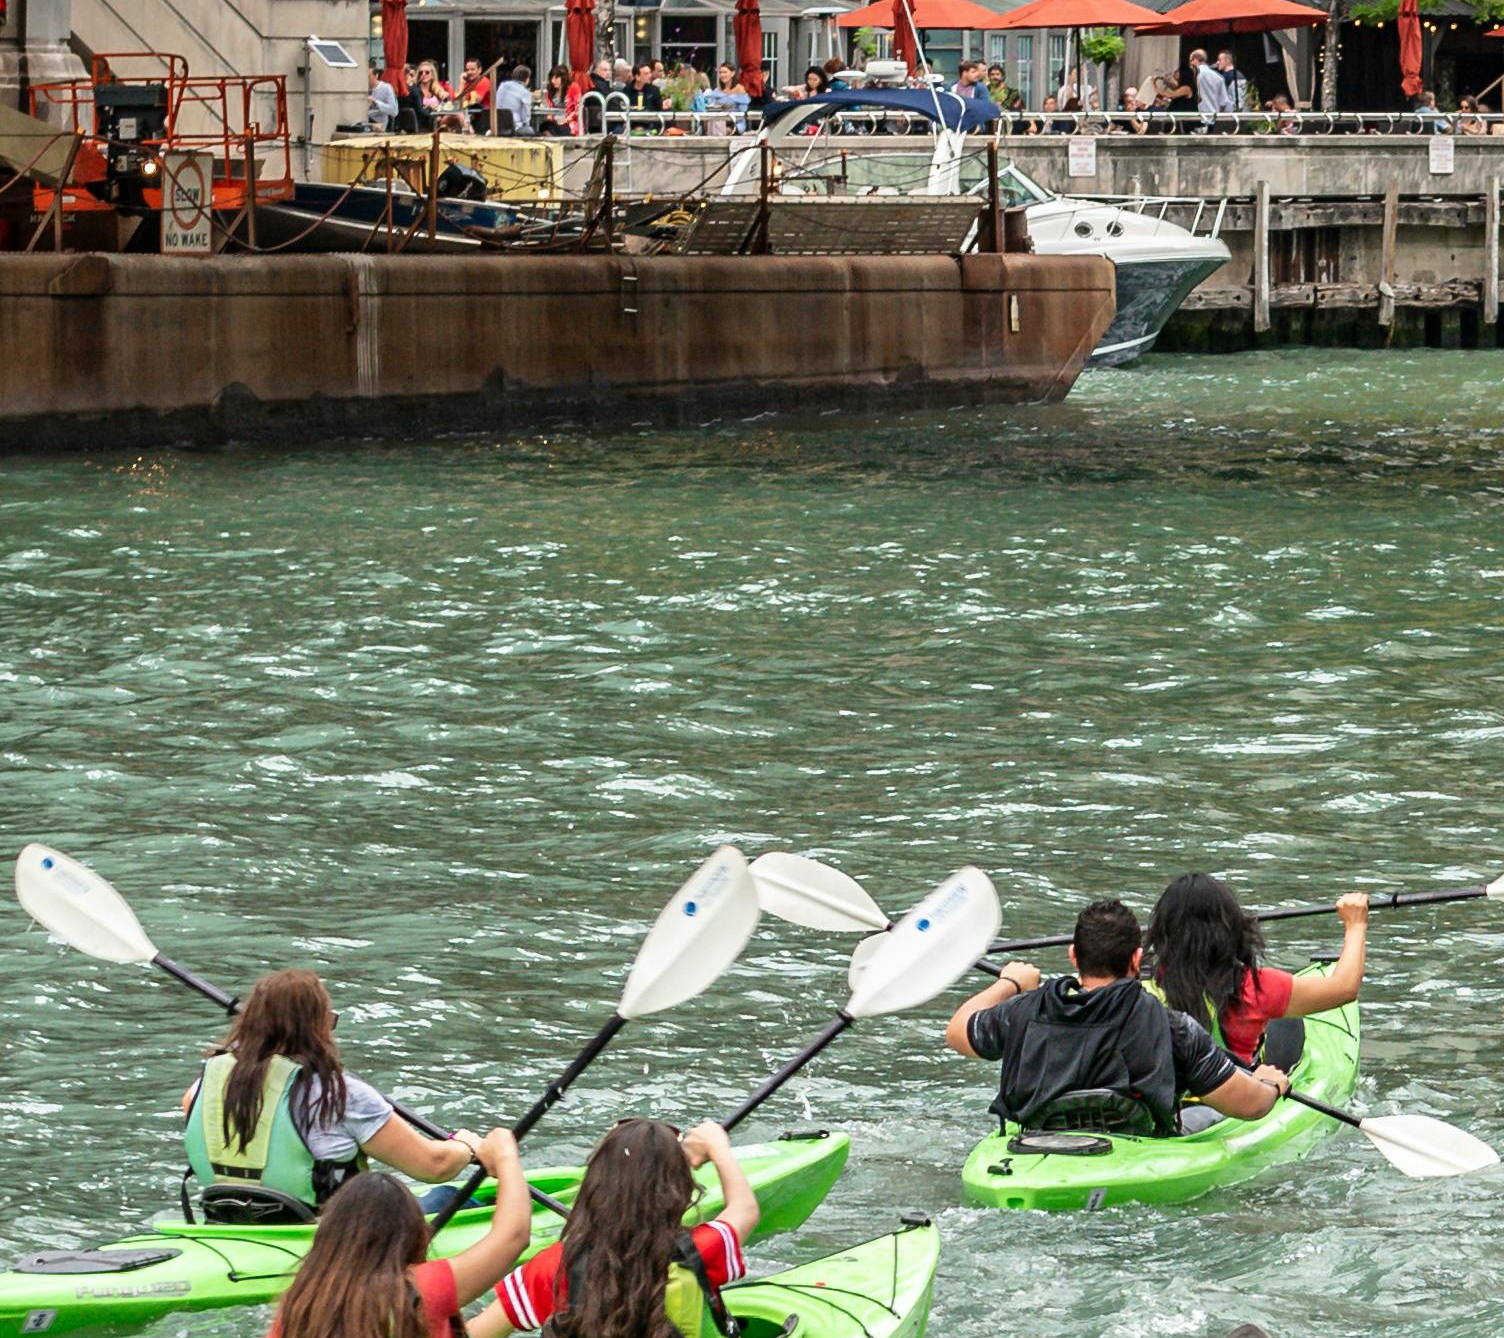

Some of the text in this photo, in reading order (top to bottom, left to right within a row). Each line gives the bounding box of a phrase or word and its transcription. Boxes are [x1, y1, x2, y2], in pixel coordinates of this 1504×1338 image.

[175, 187, 200, 202] SLOW
[165, 232, 208, 247] NO WAKE
